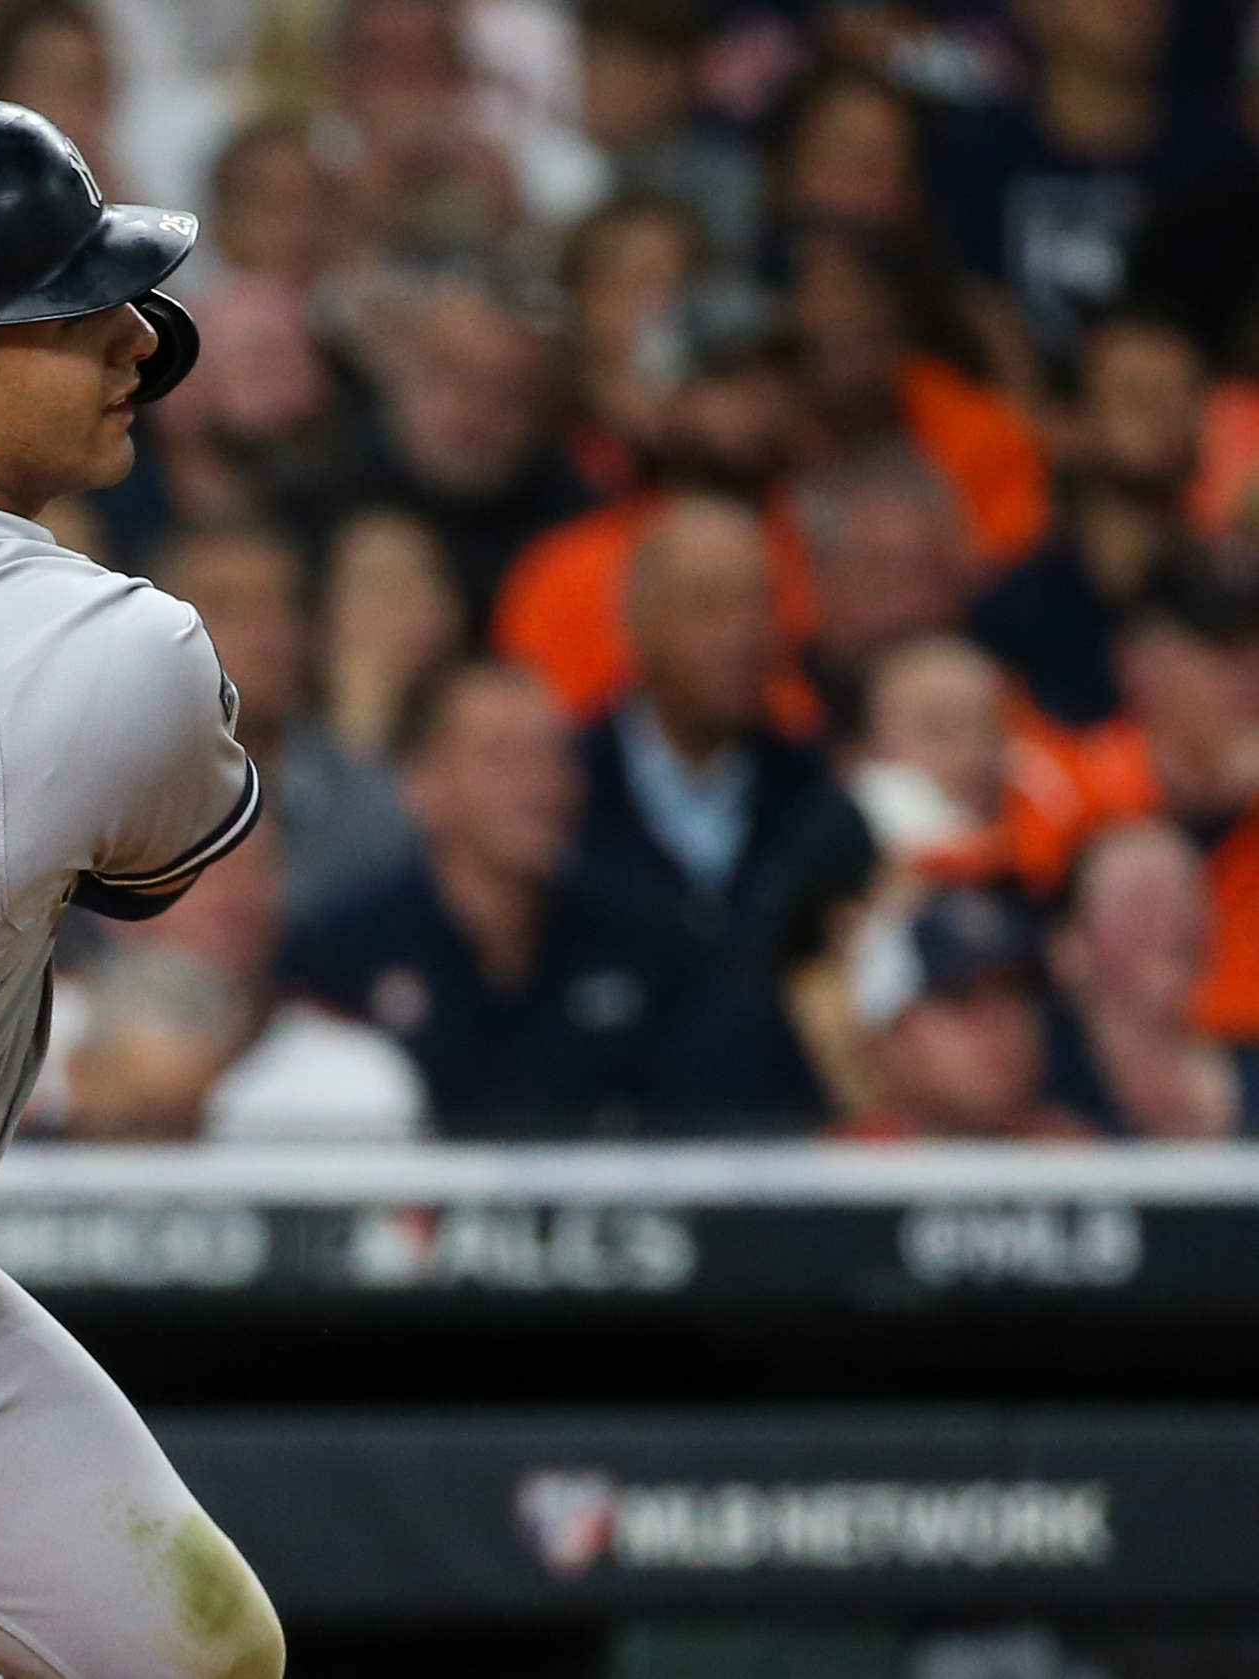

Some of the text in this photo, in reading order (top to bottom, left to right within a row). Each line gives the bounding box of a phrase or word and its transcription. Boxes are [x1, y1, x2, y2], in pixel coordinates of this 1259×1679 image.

[158, 213, 195, 237] 25
[613, 1482, 1114, 1567] MLB NETWORK
